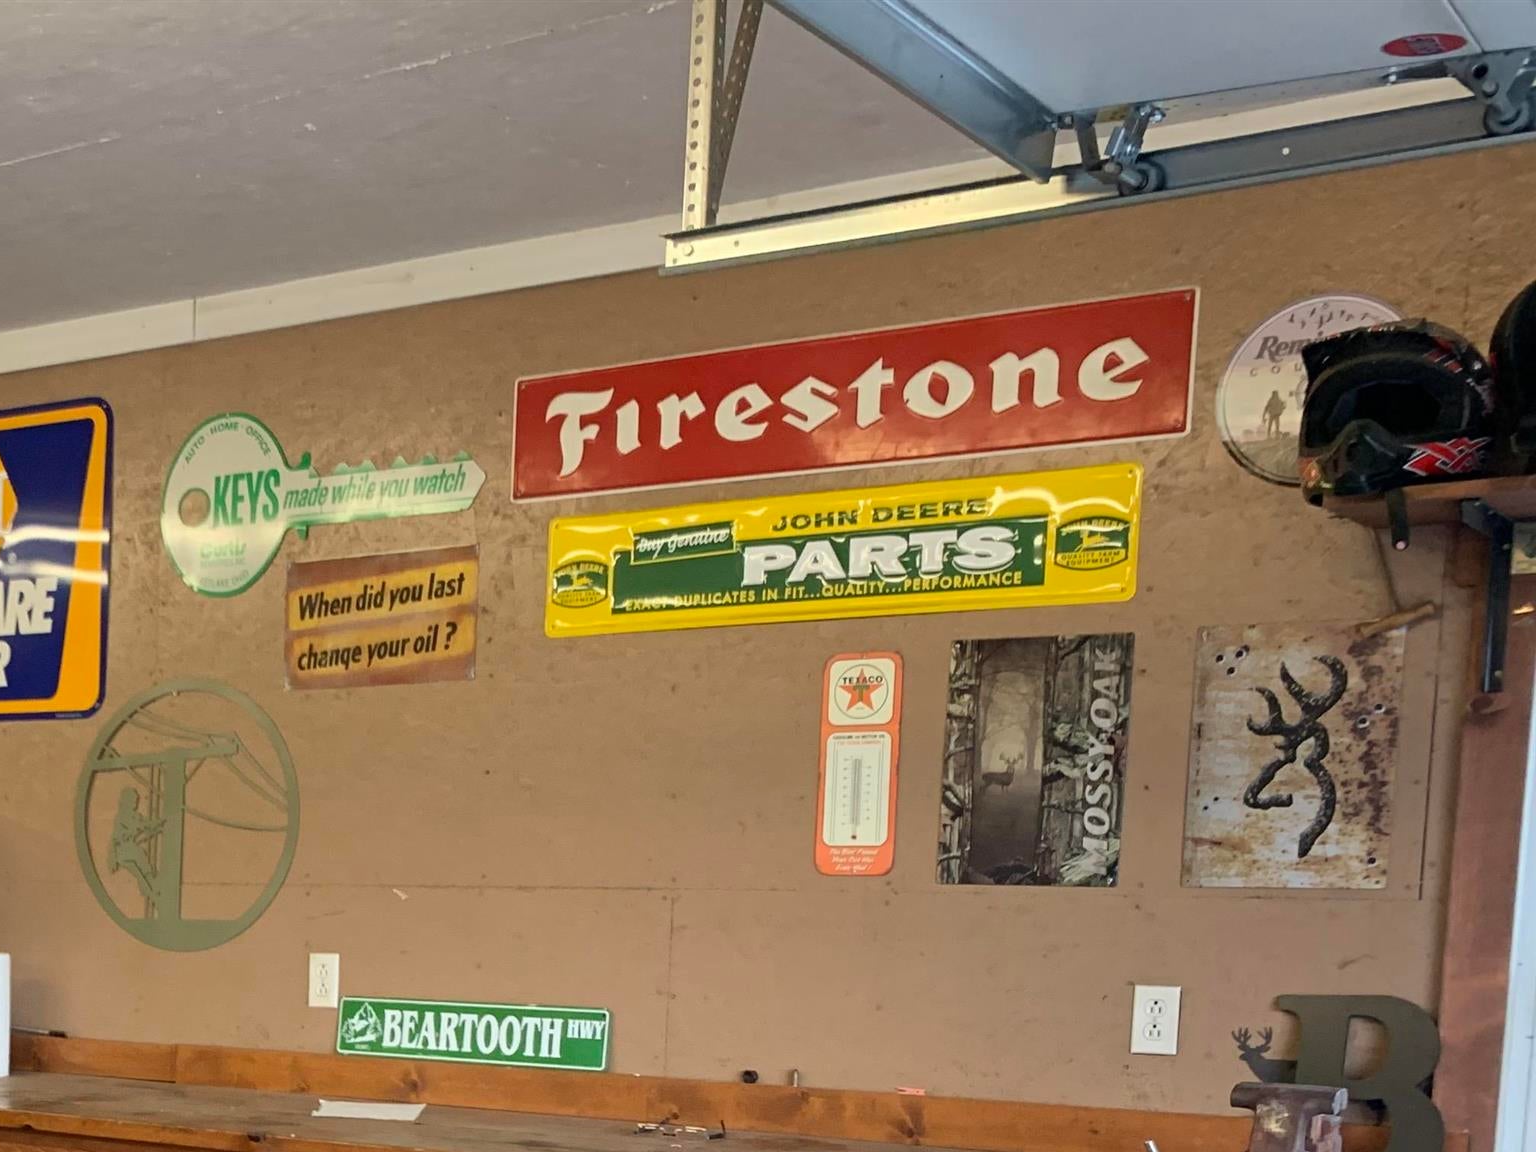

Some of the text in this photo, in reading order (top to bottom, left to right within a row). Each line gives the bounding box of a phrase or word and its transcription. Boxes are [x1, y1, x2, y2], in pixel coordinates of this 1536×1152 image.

[209, 420, 240, 435] HOME
[545, 336, 1150, 478] Firestone
[184, 430, 206, 465] AUTO
[244, 424, 272, 457] OFFICE
[213, 468, 281, 528] KEYS
[283, 463, 466, 510] made while you watch
[772, 498, 989, 532] JOHN DEERE
[636, 526, 730, 560] Buy Genuine
[741, 525, 1019, 587] PARTS
[297, 572, 465, 621] When did you last
[625, 596, 674, 611] EXACT
[675, 590, 756, 608] DUPLICATES
[762, 588, 778, 601] IN
[297, 642, 362, 672] change
[367, 636, 410, 668] your
[413, 624, 439, 654] oil
[842, 675, 884, 684] TEXACO
[1082, 647, 1121, 876] MOSSY OAK
[382, 1008, 606, 1059] BEARTOOTH HWY
